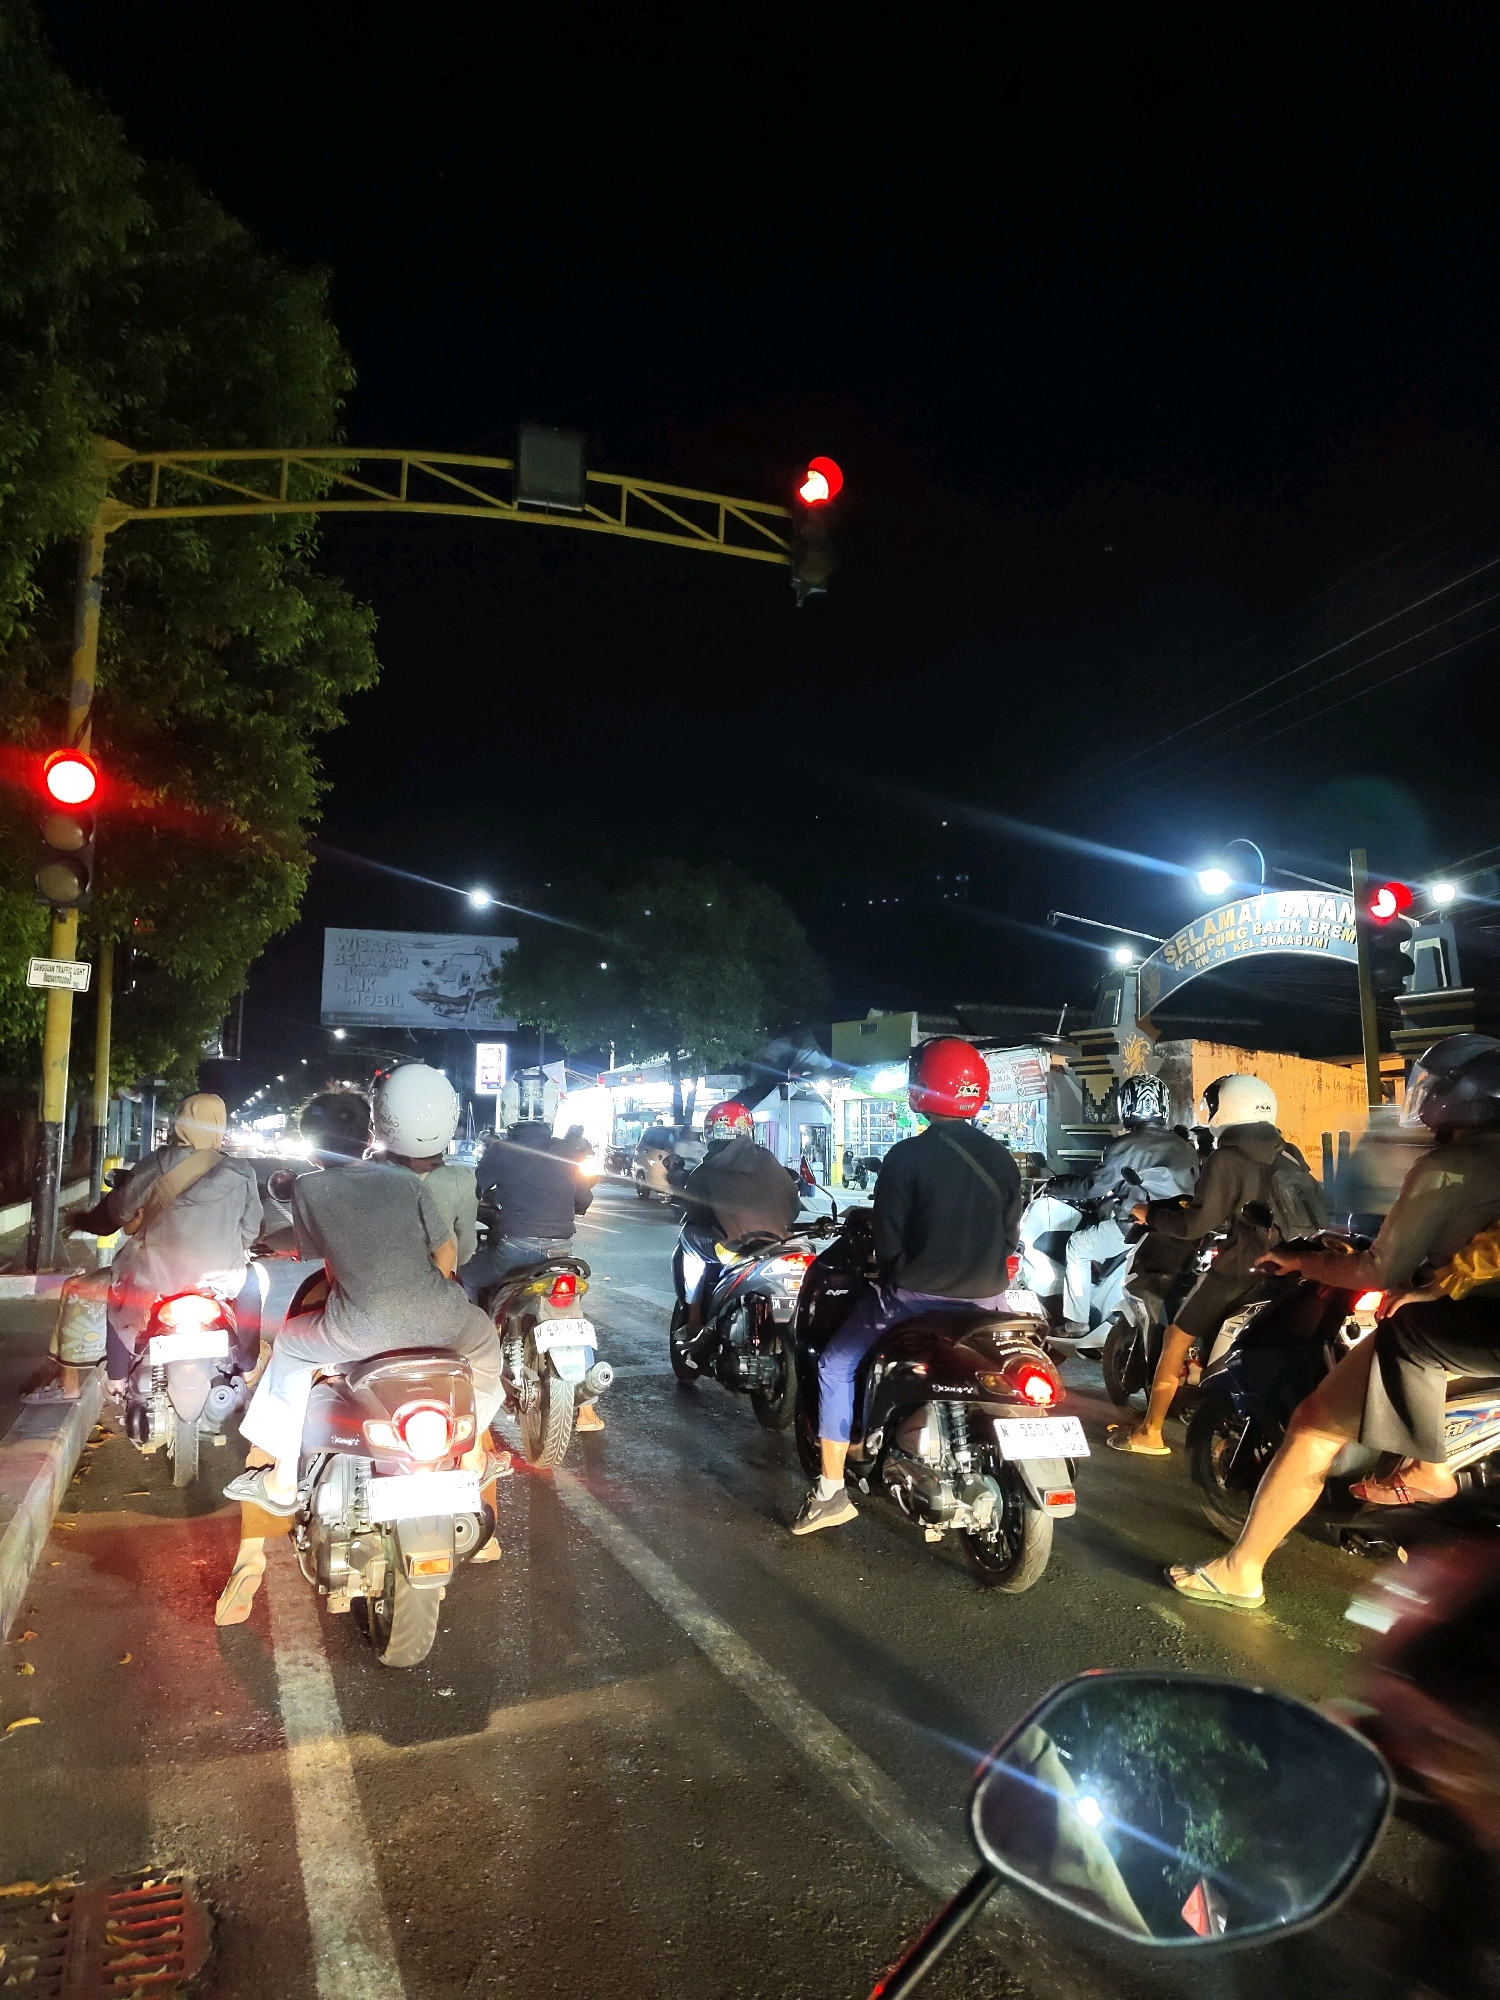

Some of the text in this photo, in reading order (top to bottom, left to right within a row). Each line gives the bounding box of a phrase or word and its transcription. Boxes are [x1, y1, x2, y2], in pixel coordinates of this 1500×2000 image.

[1163, 895, 1356, 964] SELAMAT DATAN
[335, 936, 402, 954] WISATA
[1174, 918, 1357, 972] KAMPUNG BATIK BREM
[334, 975, 377, 993] NAIK
[345, 991, 405, 1008] MOBIL
[990, 1083, 1013, 1093] ROSIR
